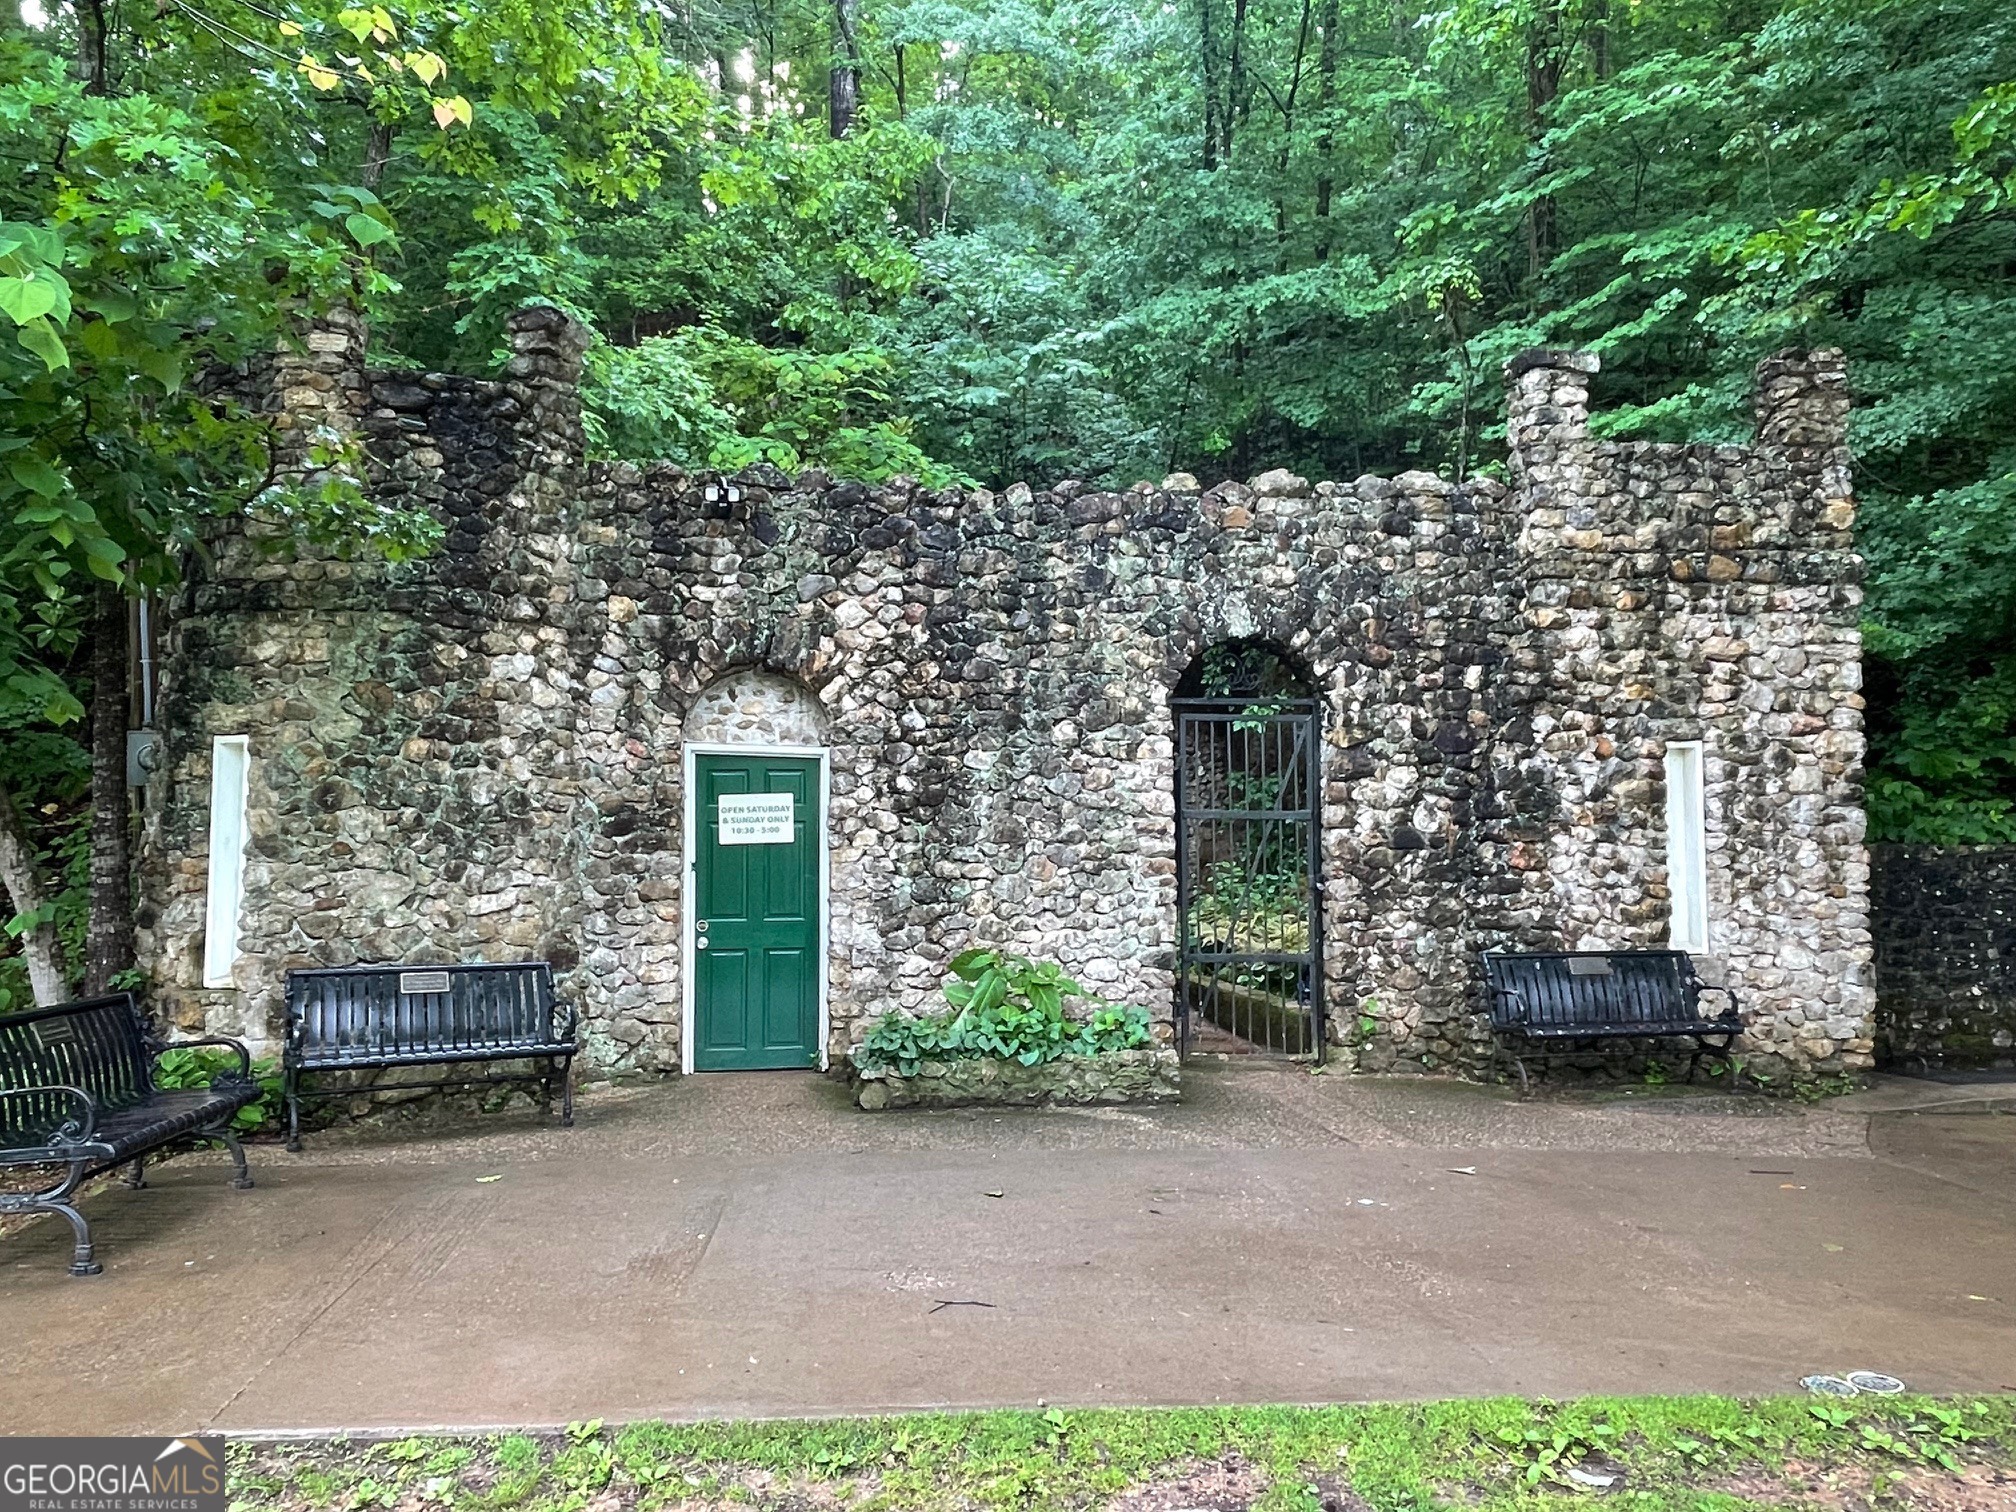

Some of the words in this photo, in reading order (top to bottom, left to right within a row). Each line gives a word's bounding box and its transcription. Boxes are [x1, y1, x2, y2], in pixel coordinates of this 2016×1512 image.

[721, 806, 744, 814] OPEN
[746, 805, 791, 813] SATURDAY
[730, 816, 765, 824] SUNDAY
